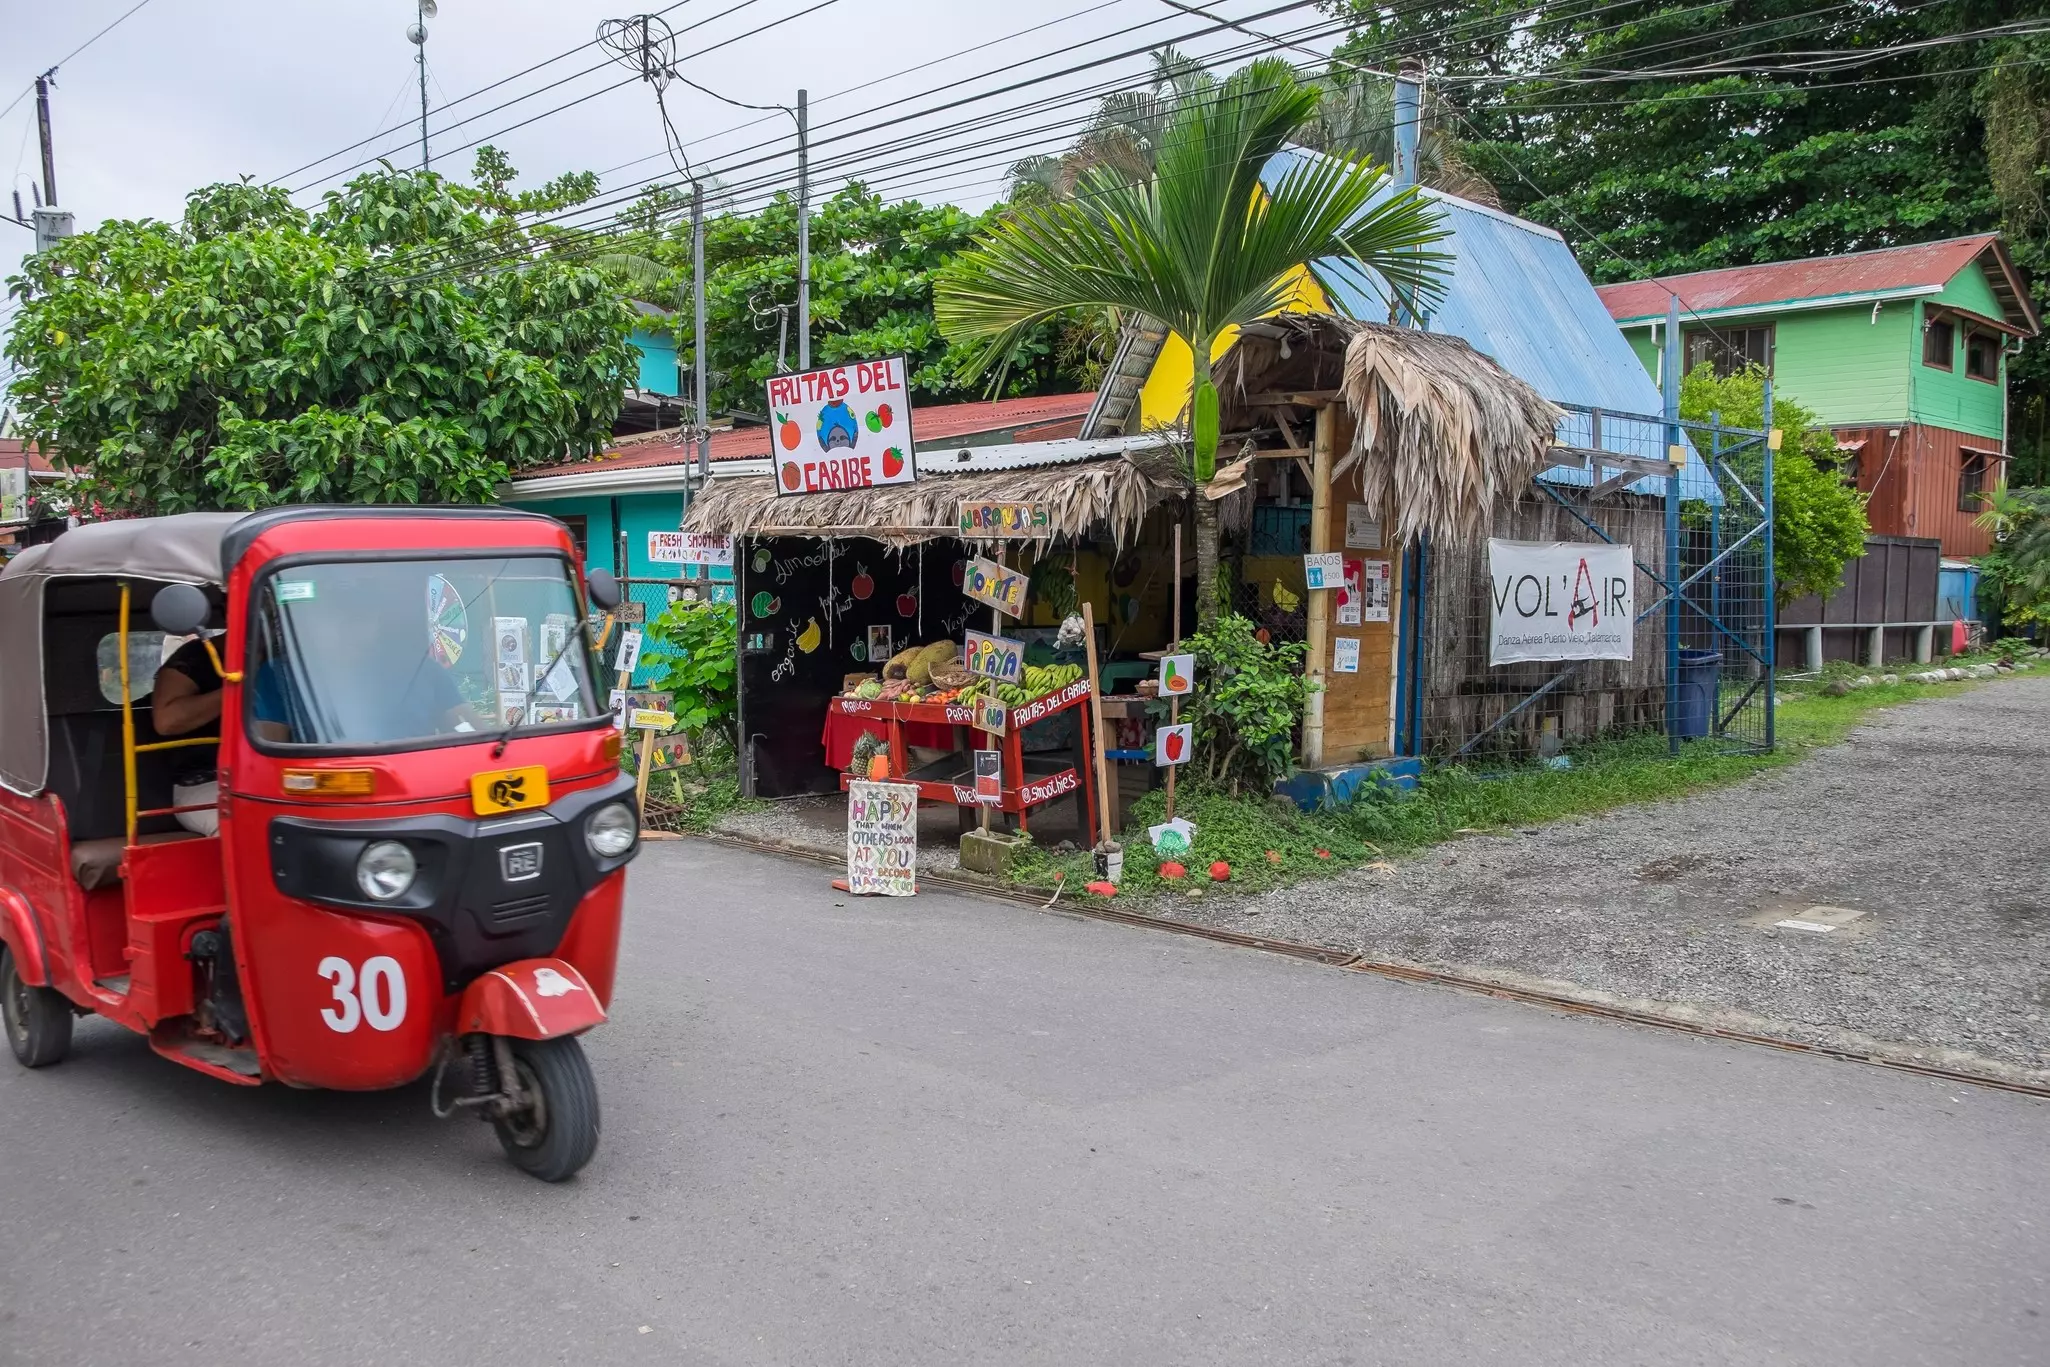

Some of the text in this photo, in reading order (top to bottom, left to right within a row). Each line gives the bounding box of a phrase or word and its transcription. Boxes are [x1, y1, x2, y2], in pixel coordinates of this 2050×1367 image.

[770, 361, 900, 407] FRUTAS DEL
[804, 457, 872, 492] CARIBE
[961, 503, 1047, 533] NARANJAS
[660, 534, 730, 549] FRESH SMOOTHIES
[1307, 555, 1341, 567] BAÑOS
[967, 566, 1018, 604] TOMATE
[1490, 558, 1627, 631] VOL'AIR
[1337, 640, 1357, 650] DUCHAS
[1498, 634, 1520, 646] Danza
[1544, 632, 1567, 644] Puerto
[966, 639, 1017, 676] PAPAYA
[842, 700, 872, 713] MANGO
[1013, 678, 1091, 728] FRUTAS DEL CARIBE
[946, 707, 974, 723] PAPAY
[867, 791, 899, 801] BE SO
[852, 800, 913, 822] HAPPY
[856, 821, 875, 829] THAT
[852, 831, 915, 846] OTHERS LOOK
[854, 847, 908, 867] AT YOU
[854, 865, 911, 879] THEY BECOME
[852, 876, 913, 892] HAPPY TOO
[317, 956, 408, 1034] 30
